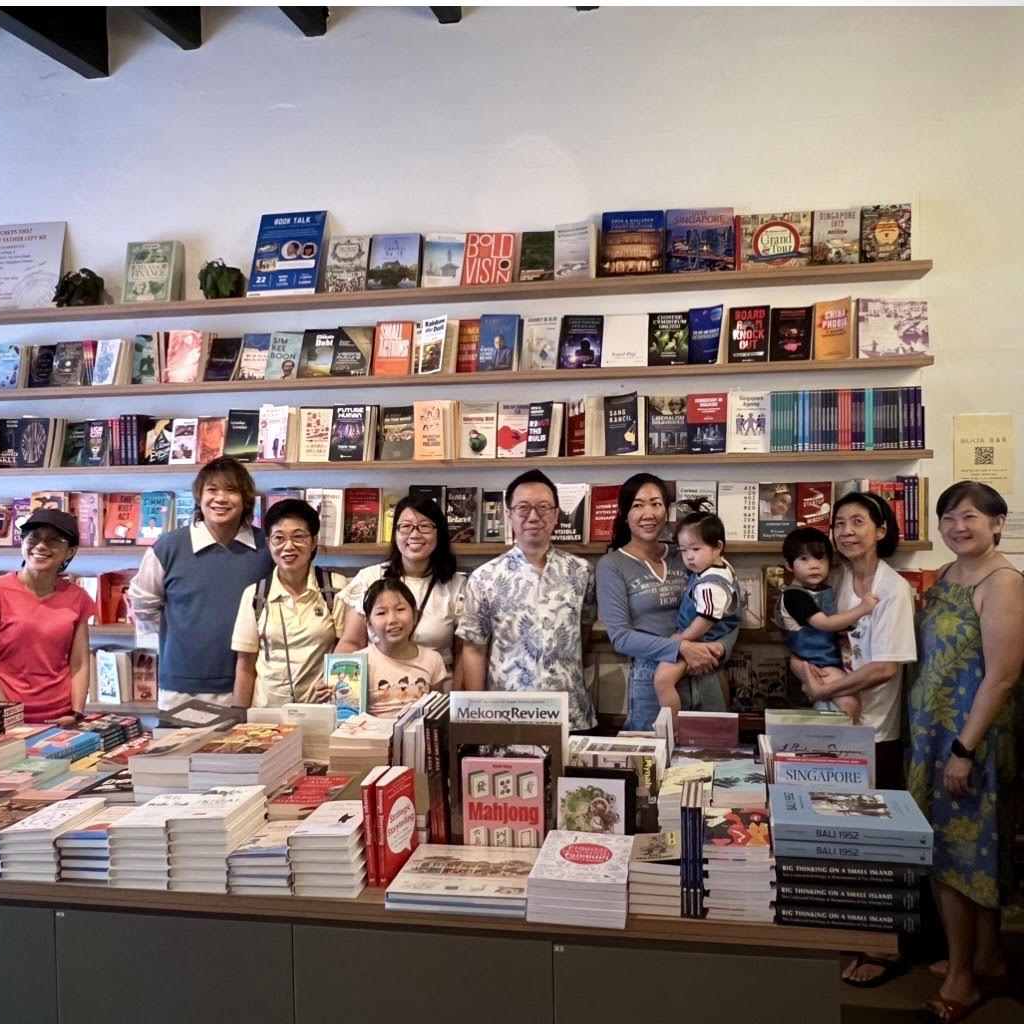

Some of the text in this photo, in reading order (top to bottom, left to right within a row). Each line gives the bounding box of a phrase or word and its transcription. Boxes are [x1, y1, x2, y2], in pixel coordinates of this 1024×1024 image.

[818, 210, 856, 220] SINGAPORE
[274, 216, 311, 226] BOOK TALK
[674, 215, 724, 226] SINGAPORE
[2, 236, 24, 244] FATHER
[760, 231, 792, 247] Grand
[466, 233, 513, 259] BOLD
[466, 257, 512, 284] VISION
[735, 310, 766, 320] BOARD
[380, 323, 403, 340] SMALL
[733, 330, 765, 340] KNOCK
[273, 336, 288, 345] SIM
[738, 340, 758, 350] OUT
[271, 344, 286, 352] KEE
[378, 339, 409, 357] ACTIONS
[270, 353, 296, 361] BOON
[786, 769, 862, 784] SINGAPORE
[468, 802, 539, 825] Mahjong
[816, 829, 859, 839] BALI 1952
[816, 846, 859, 856] BALI 1952
[869, 915, 893, 923] ISLAND
